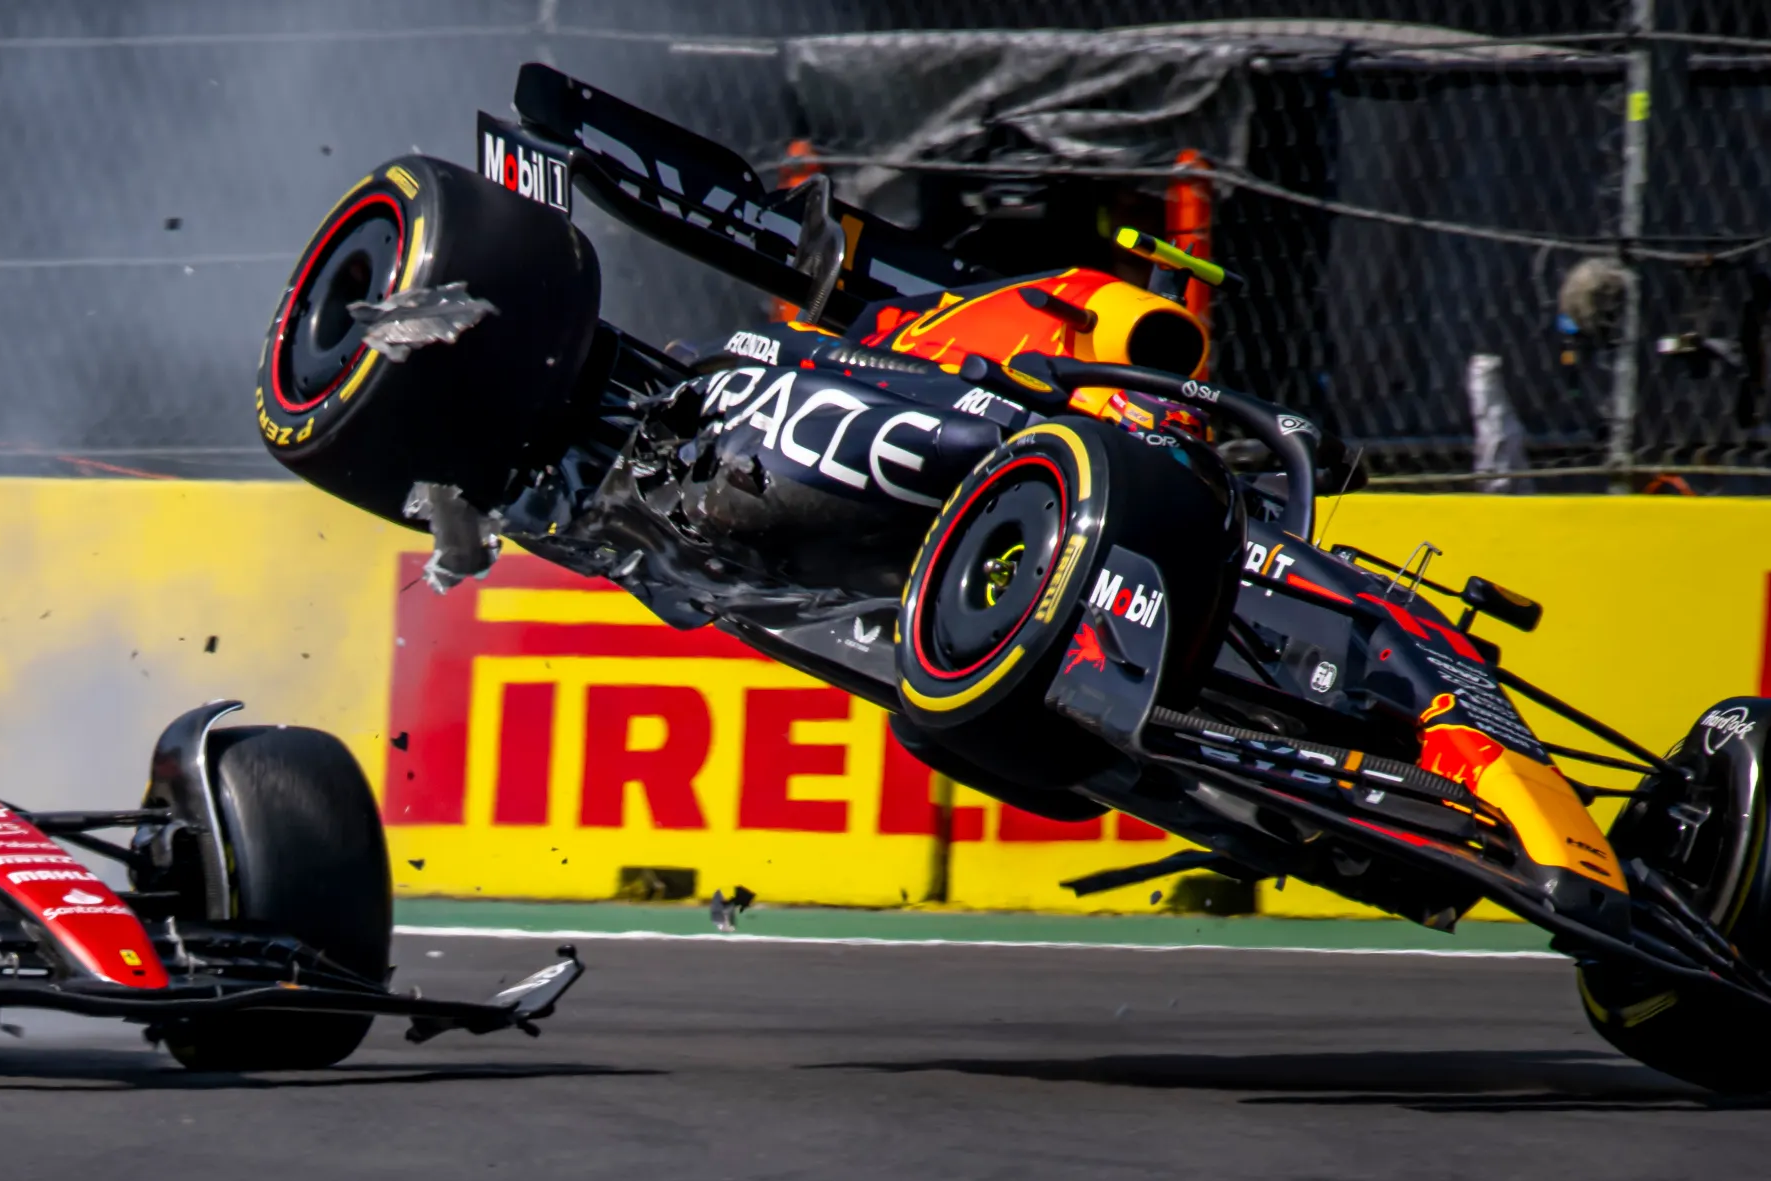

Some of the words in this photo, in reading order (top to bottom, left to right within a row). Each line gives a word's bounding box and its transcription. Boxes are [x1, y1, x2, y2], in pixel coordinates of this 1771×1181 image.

[484, 131, 545, 204] Mobil
[724, 331, 781, 366] HONDA
[952, 387, 1026, 417] RO
[701, 366, 942, 508] RACLE
[1089, 568, 1164, 629] Mobil
[6, 869, 100, 885] MAHL
